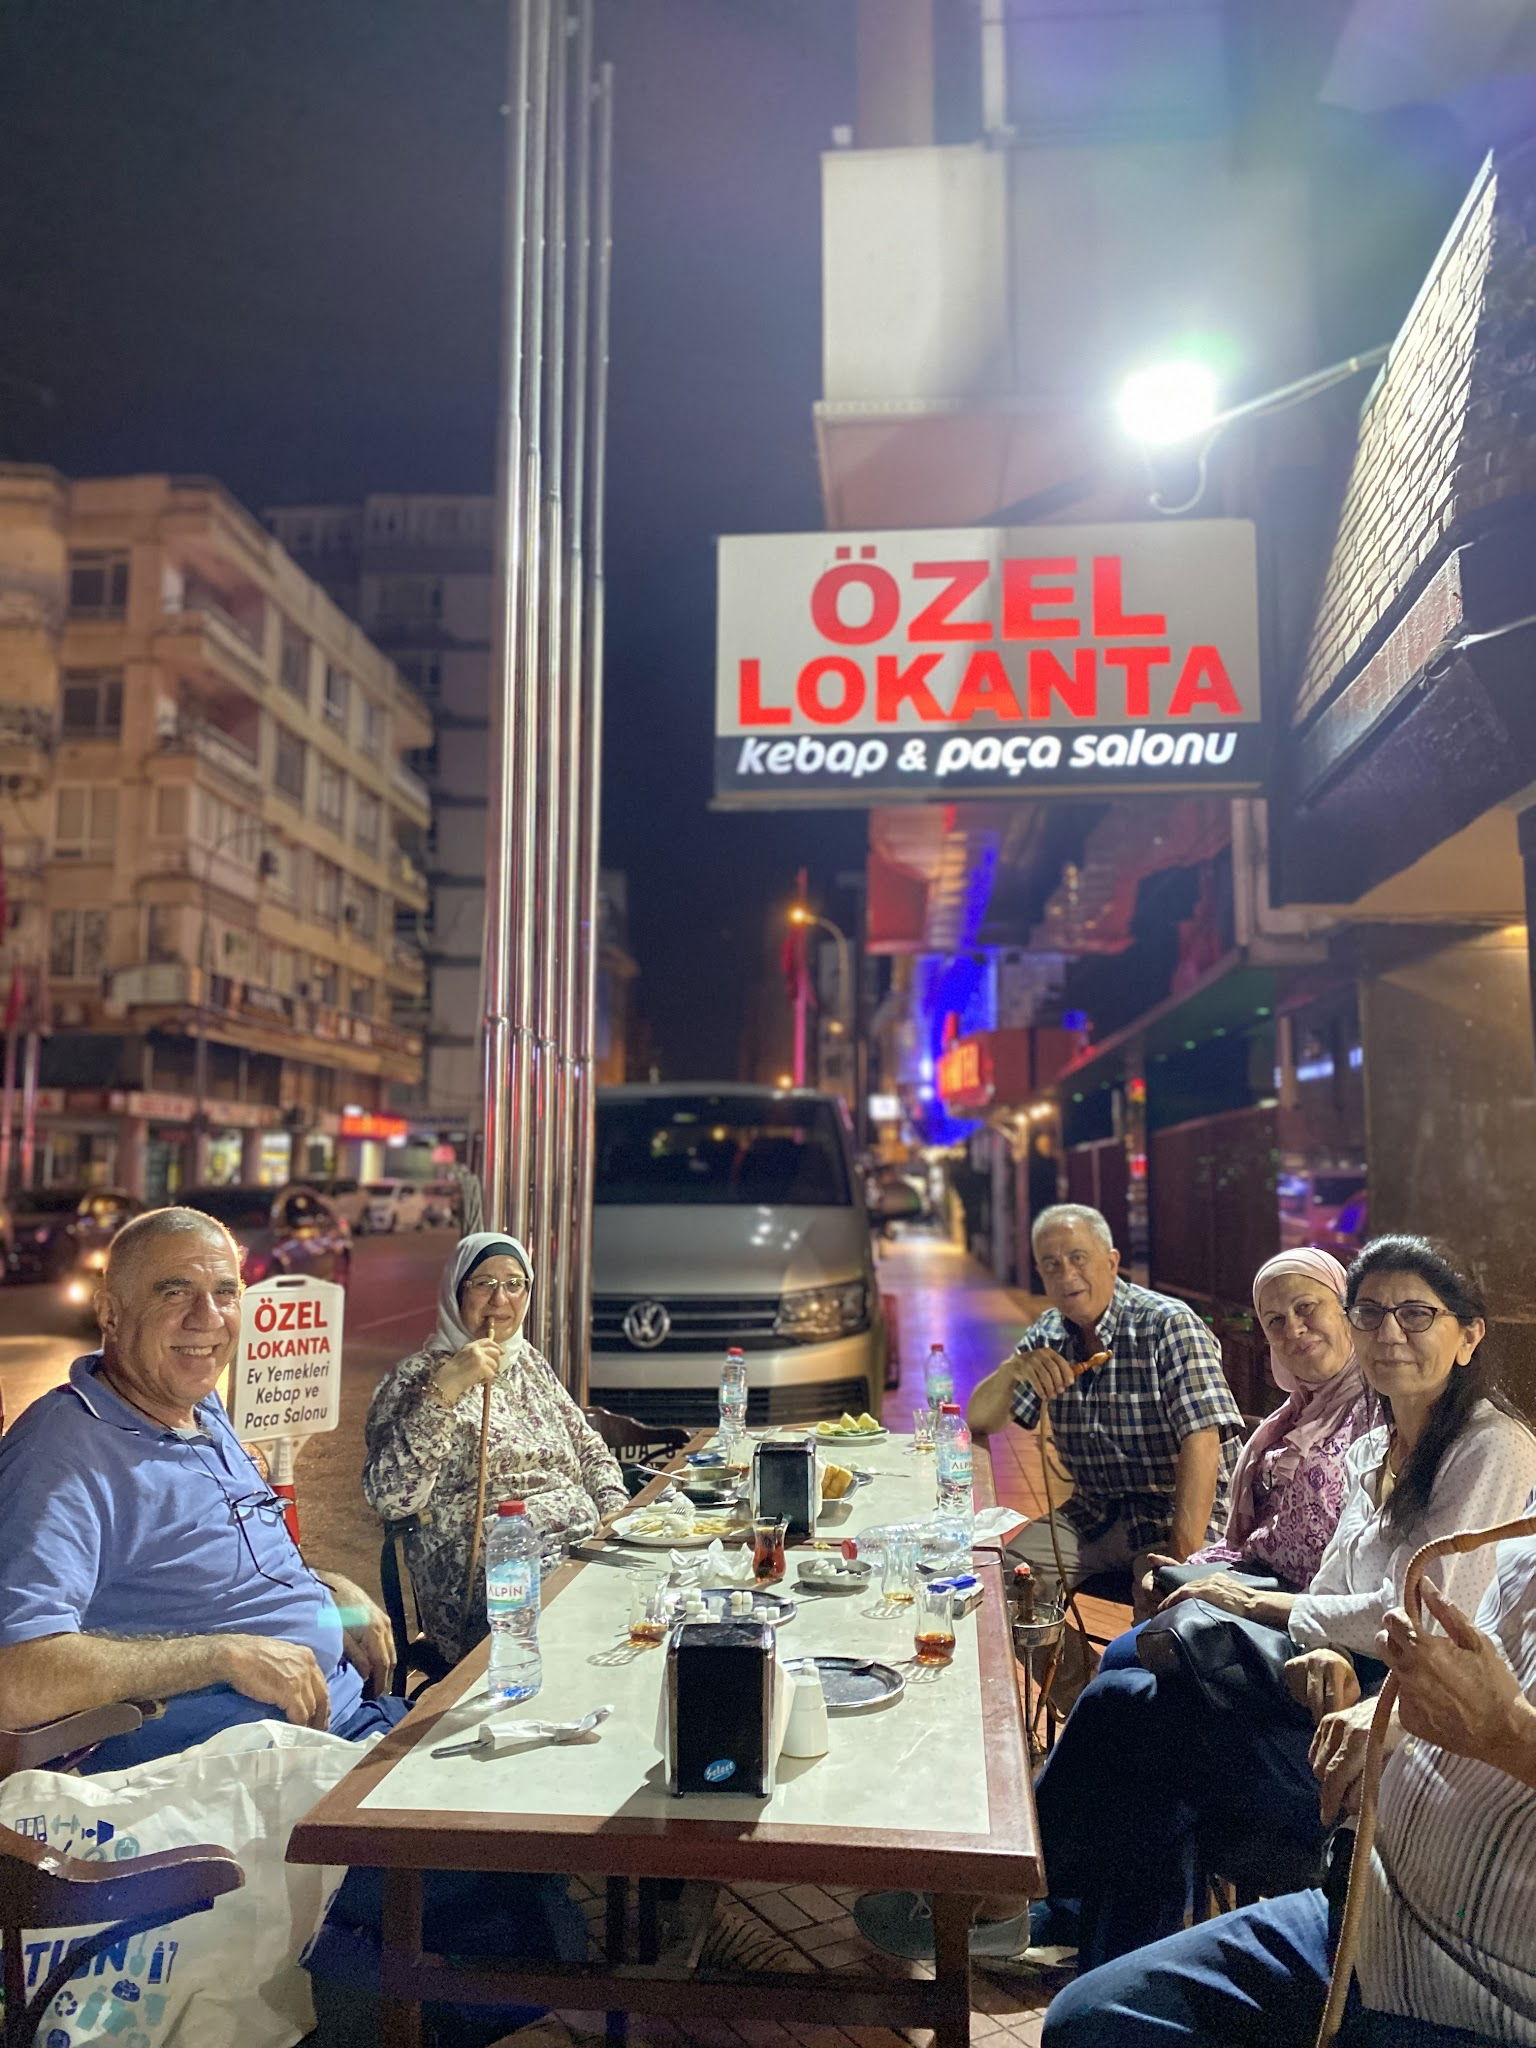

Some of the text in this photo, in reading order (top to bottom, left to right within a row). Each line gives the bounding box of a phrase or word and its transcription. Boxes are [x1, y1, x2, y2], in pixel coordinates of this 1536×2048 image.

[811, 545, 1167, 645] ÖZEL
[738, 644, 1244, 727] LOKANTA
[736, 730, 1238, 778] kebap & paça salonu
[254, 1297, 328, 1333] ÖZEL
[247, 1336, 330, 1361] LOKANTA
[247, 1360, 330, 1384] Ev Yemekleri
[256, 1386, 319, 1405] Kebap ve
[244, 1406, 328, 1431] Paça Salonu
